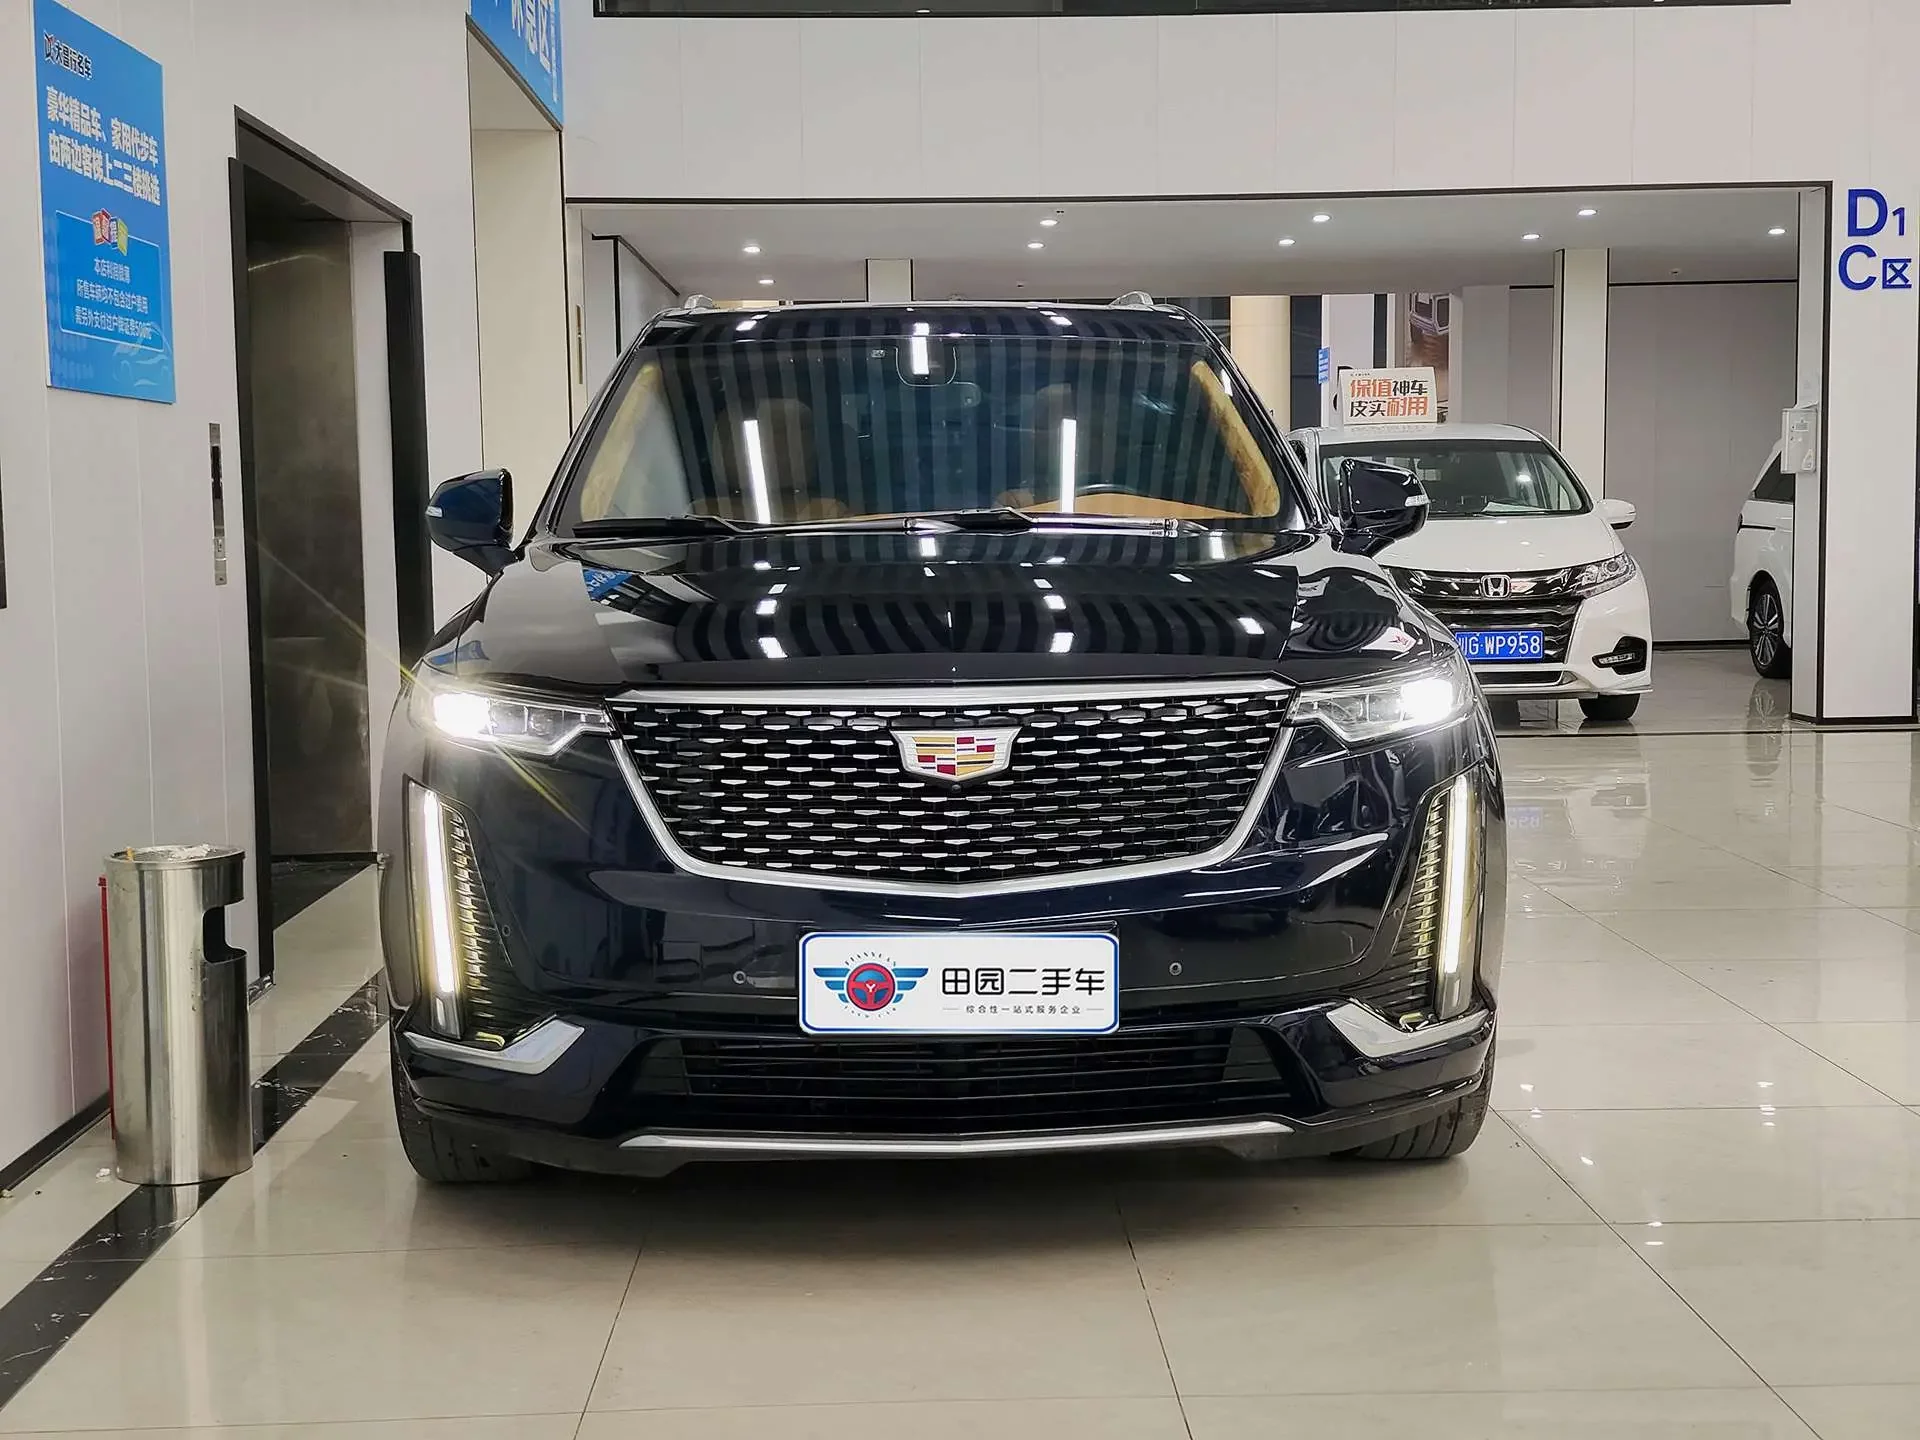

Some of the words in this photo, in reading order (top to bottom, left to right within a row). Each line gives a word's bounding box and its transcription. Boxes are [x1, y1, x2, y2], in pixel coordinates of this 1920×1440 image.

[1838, 244, 1912, 291] C区
[1350, 378, 1429, 398] 保值神车
[1349, 396, 1429, 418] 皮实耐用
[942, 967, 1106, 996] 田园二手车
[966, 1005, 1082, 1015] 综合性一站式服务企业
